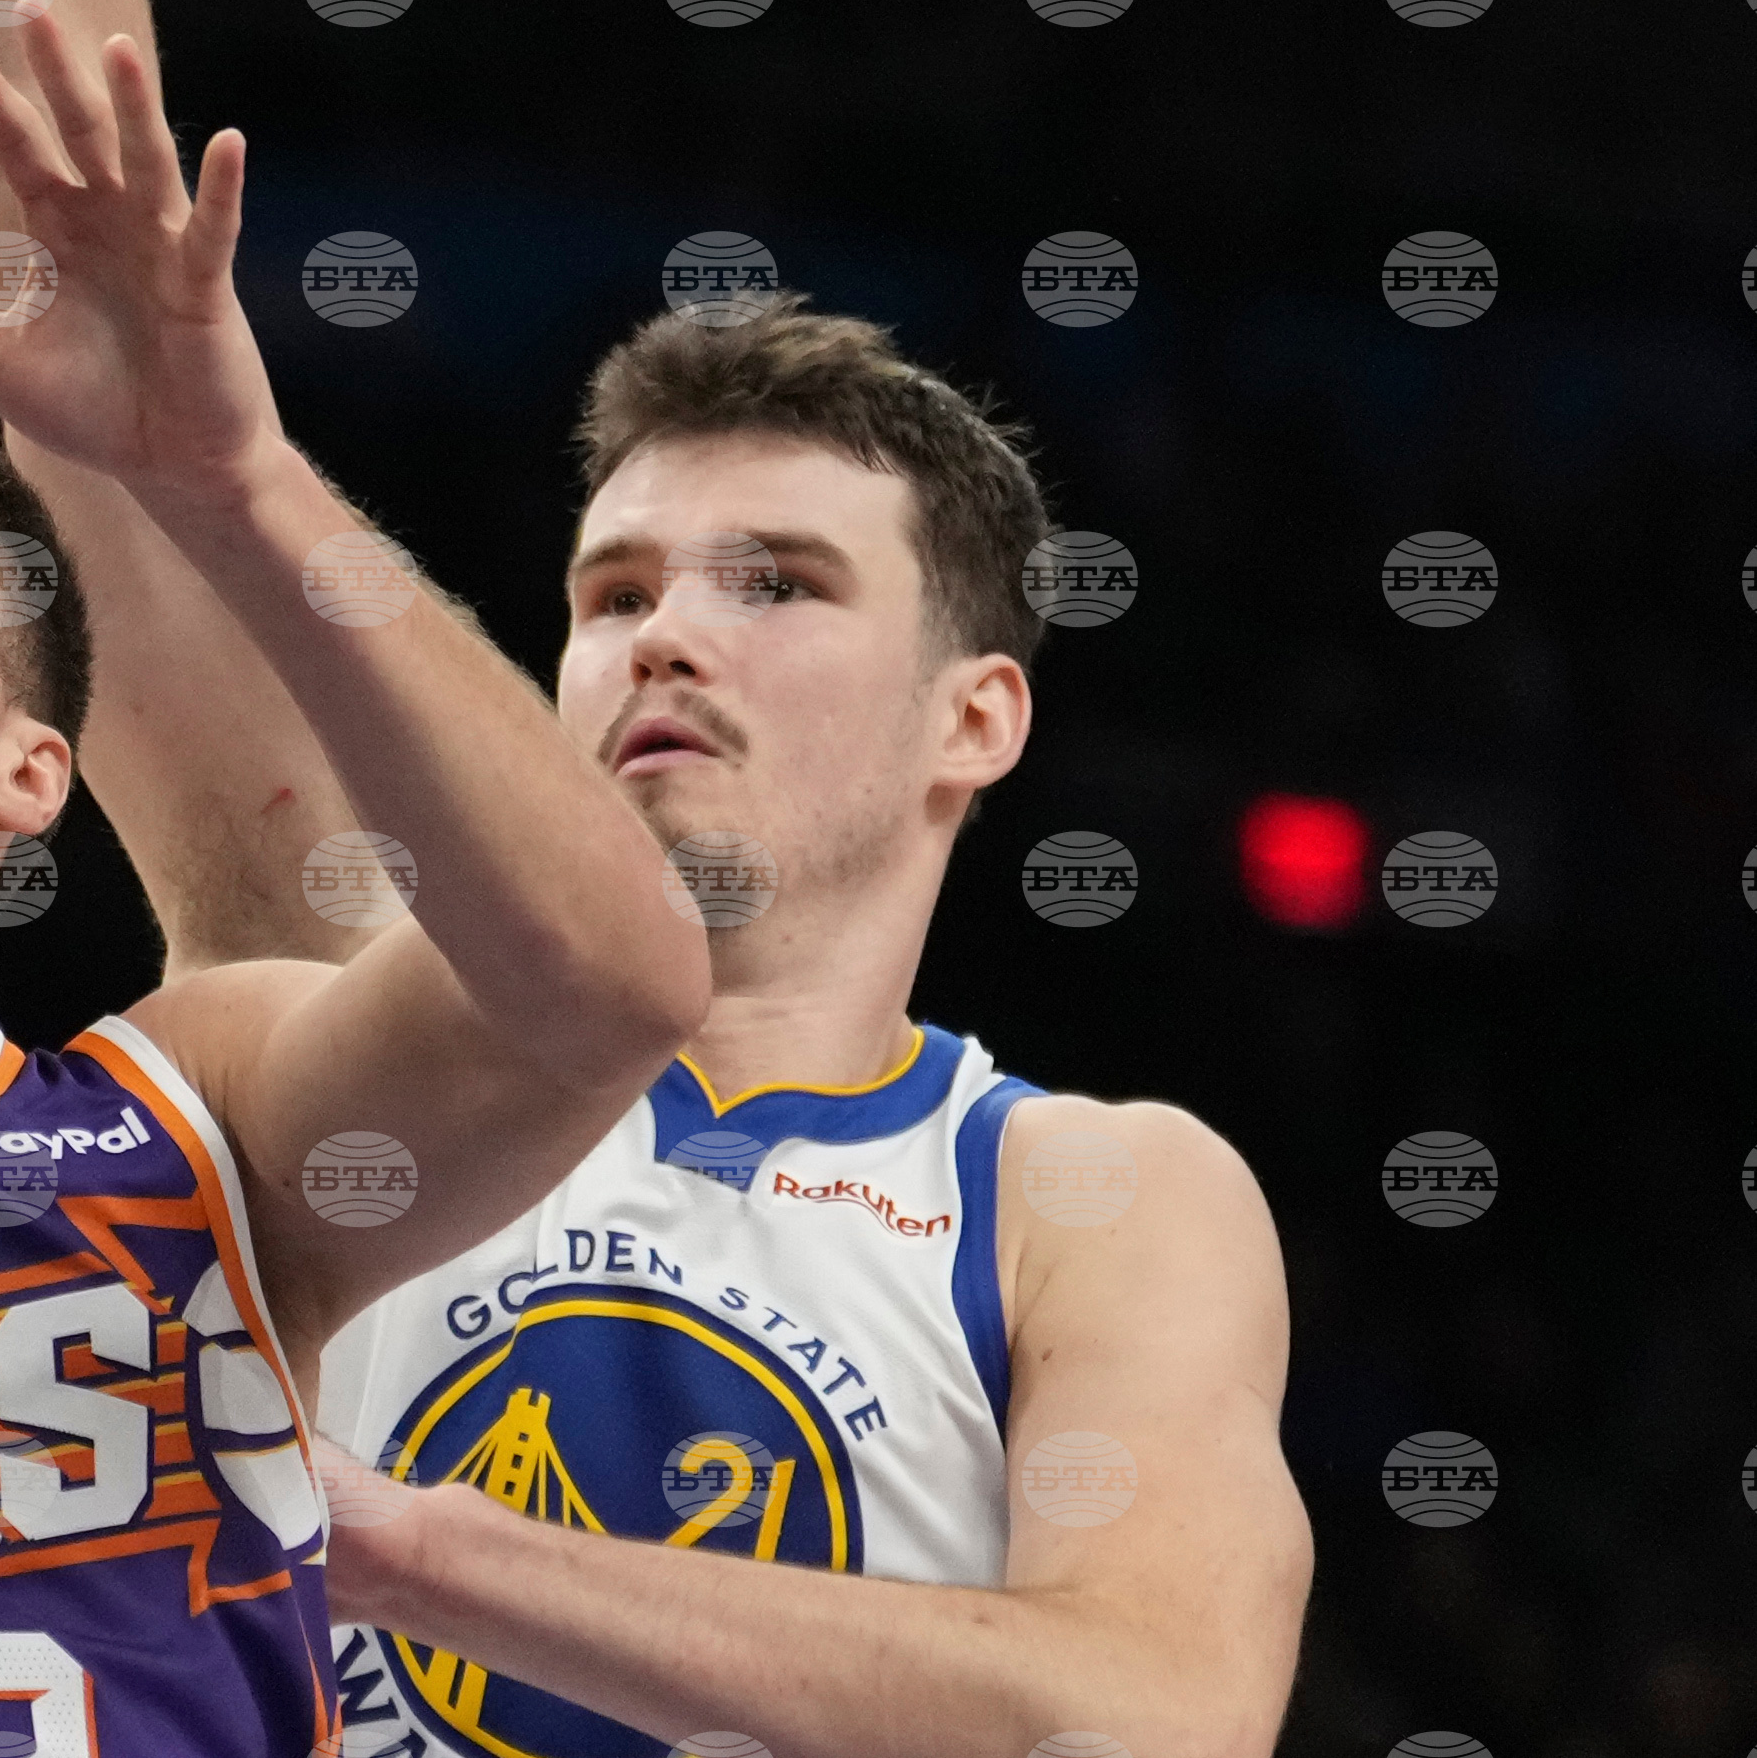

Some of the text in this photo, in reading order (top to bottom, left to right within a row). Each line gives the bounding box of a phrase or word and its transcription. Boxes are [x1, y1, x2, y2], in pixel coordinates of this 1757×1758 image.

[774, 1171, 951, 1237] Rakuten
[719, 1282, 889, 1443] STATE
[660, 1440, 795, 1562] 21
